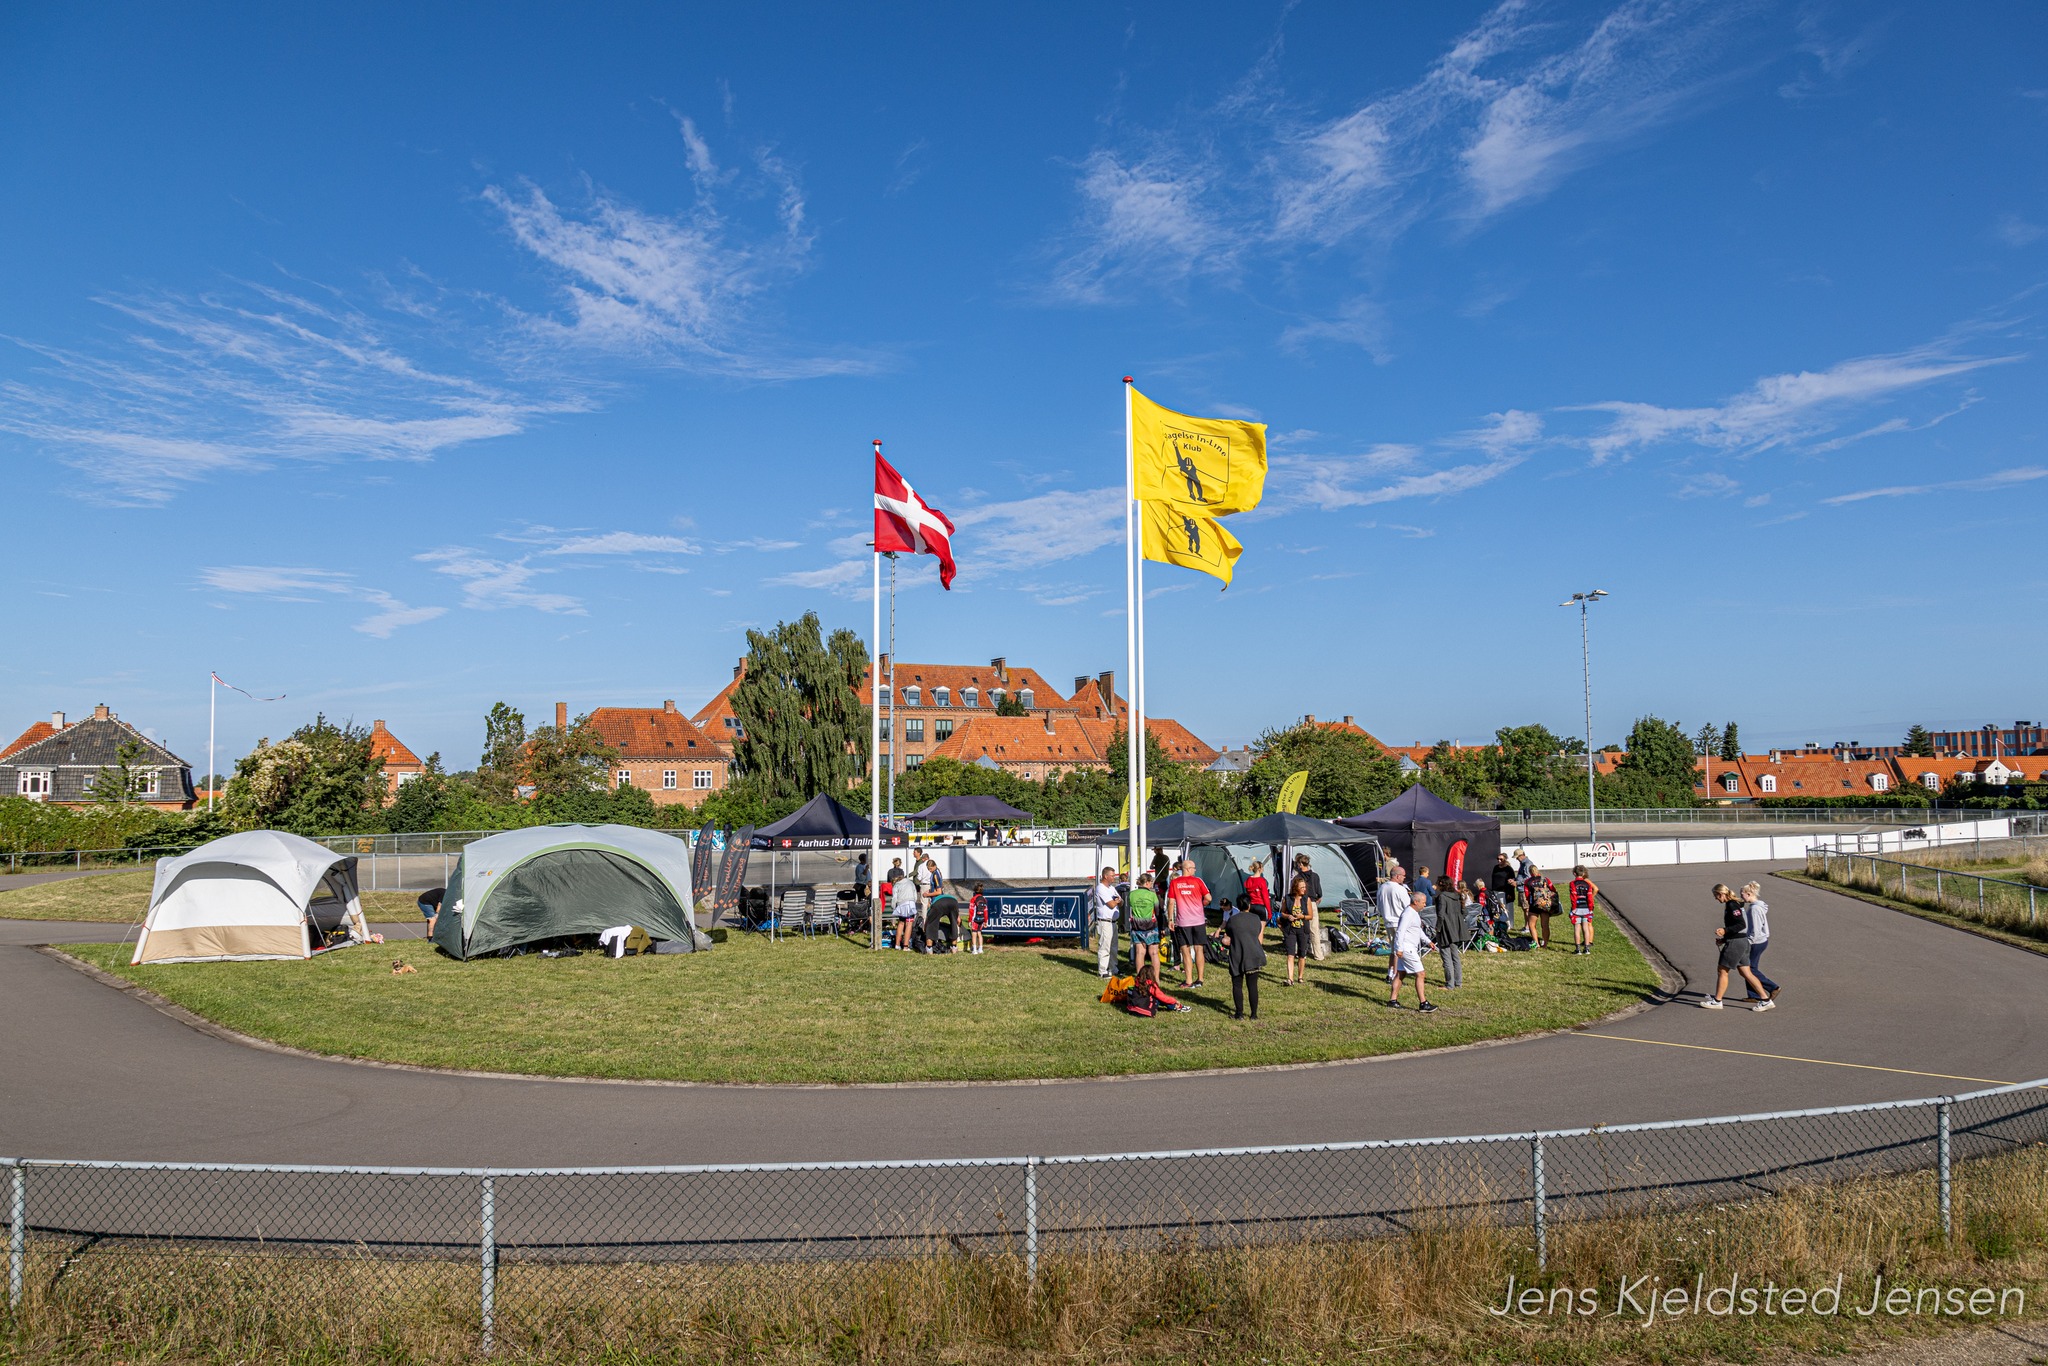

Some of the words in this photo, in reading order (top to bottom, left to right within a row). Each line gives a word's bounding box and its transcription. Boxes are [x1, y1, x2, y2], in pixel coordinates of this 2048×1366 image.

[1183, 443, 1202, 452] Klub
[798, 839, 829, 848] Aarhus
[831, 837, 852, 847] 1900
[1002, 904, 1053, 915] SLAGELSE
[986, 918, 1077, 929] ULLESKØJTESTADION
